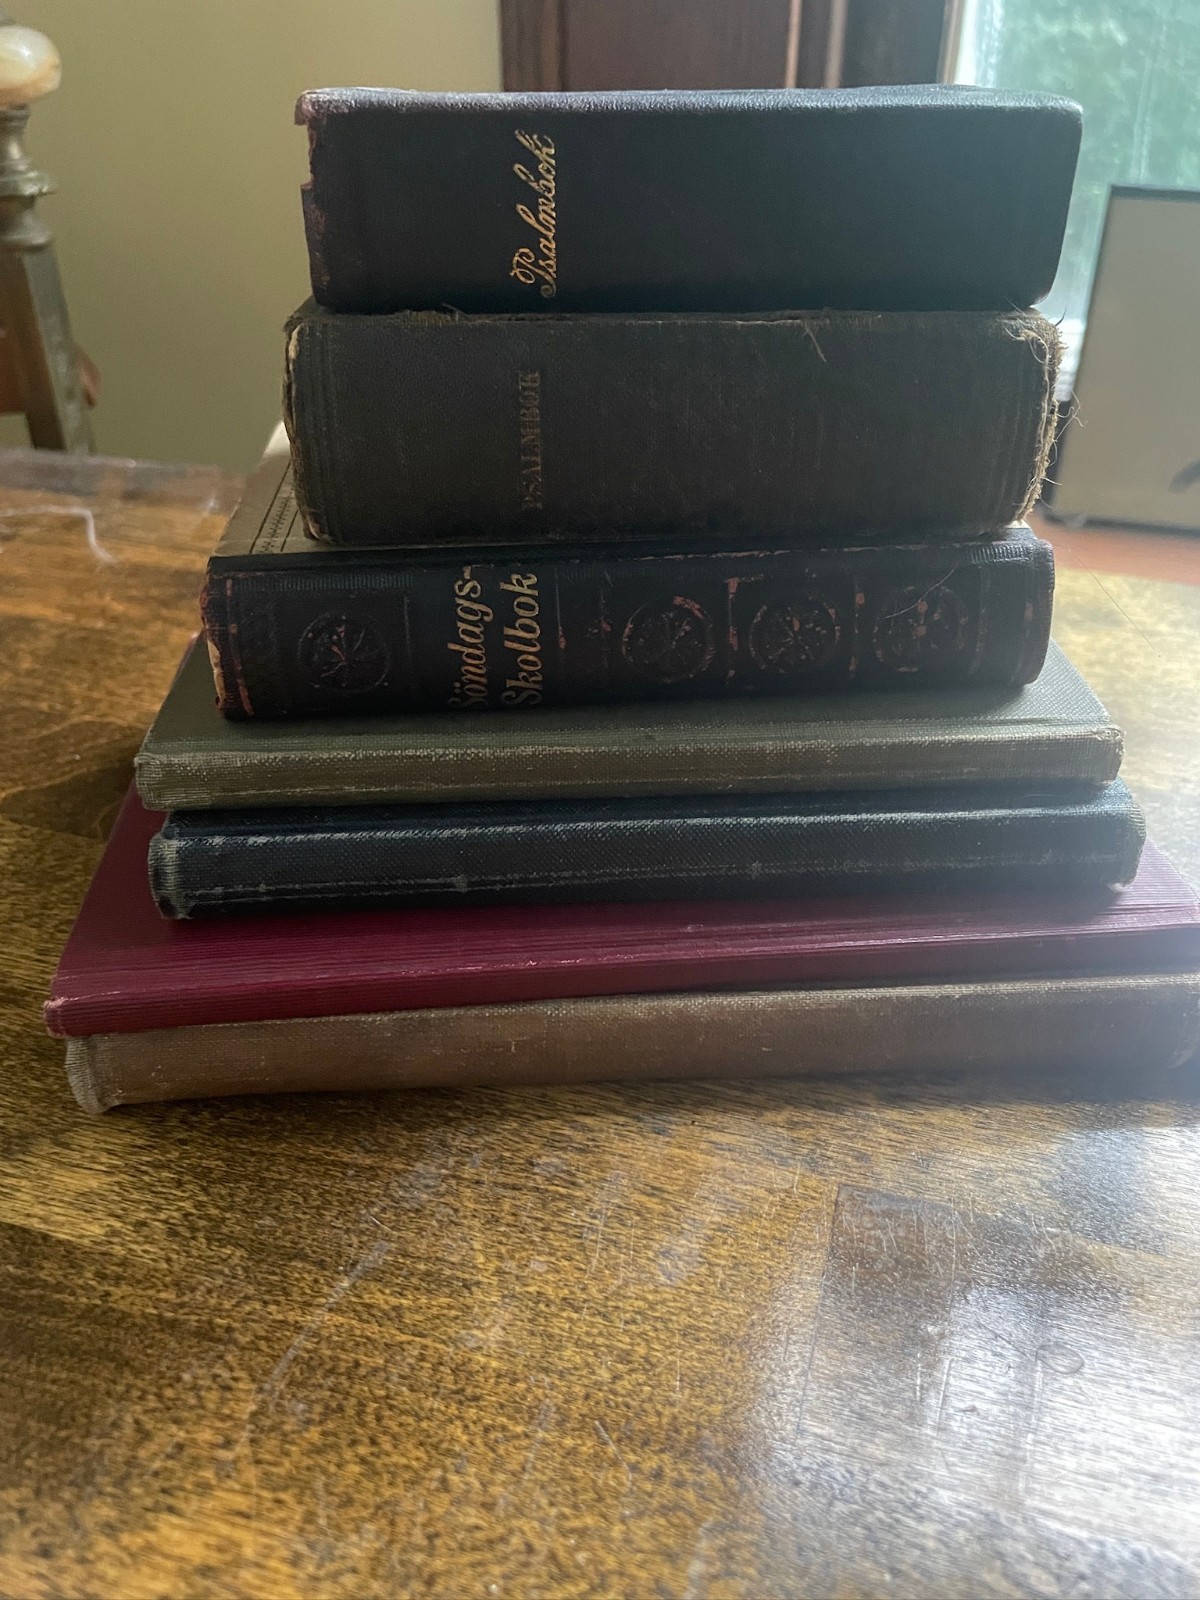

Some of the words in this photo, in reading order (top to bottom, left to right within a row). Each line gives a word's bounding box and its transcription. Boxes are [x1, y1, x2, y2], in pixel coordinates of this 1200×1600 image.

[510, 129, 556, 298] Psalmbok
[518, 371, 542, 509] PSALMBOK
[500, 573, 543, 705] Skolbok
